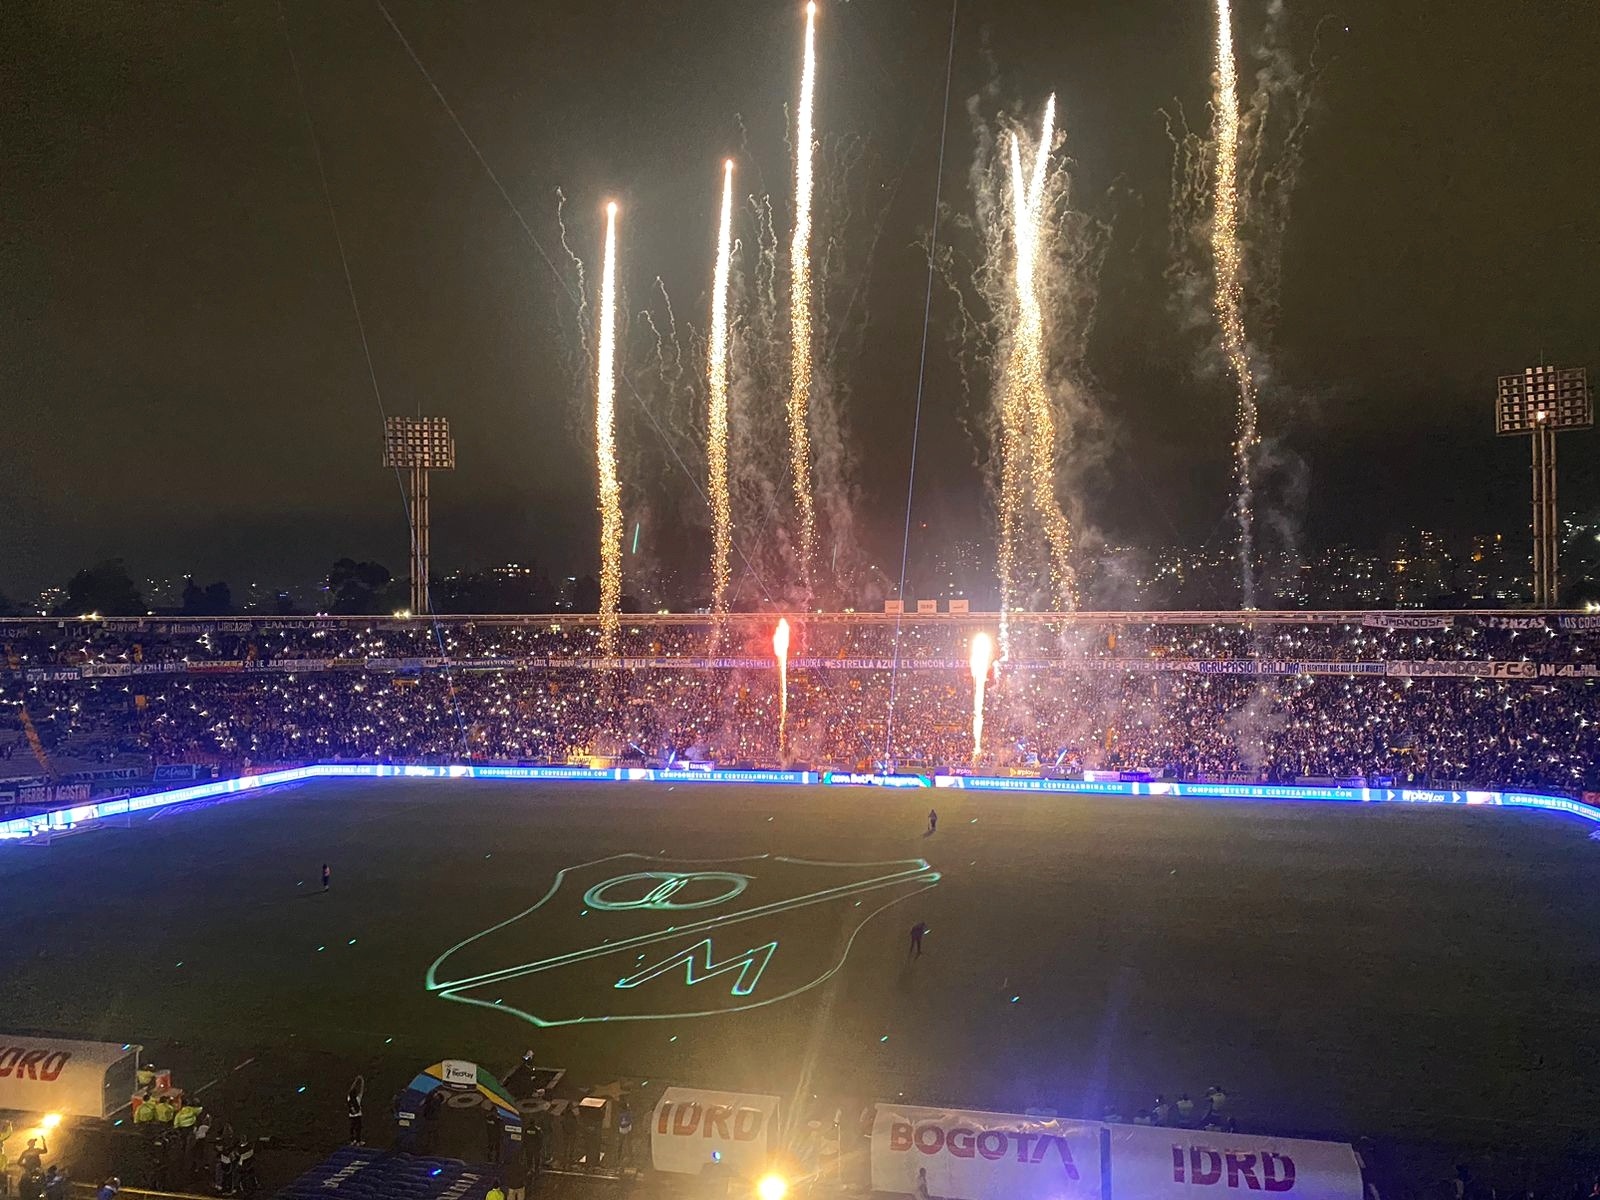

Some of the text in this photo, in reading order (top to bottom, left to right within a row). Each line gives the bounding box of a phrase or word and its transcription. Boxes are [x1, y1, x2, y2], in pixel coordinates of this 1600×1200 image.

[831, 659, 874, 669] ESTRELLA
[0, 1046, 73, 1082] DRD
[657, 1101, 764, 1142] IDRD
[1171, 1143, 1296, 1192] IDRD
